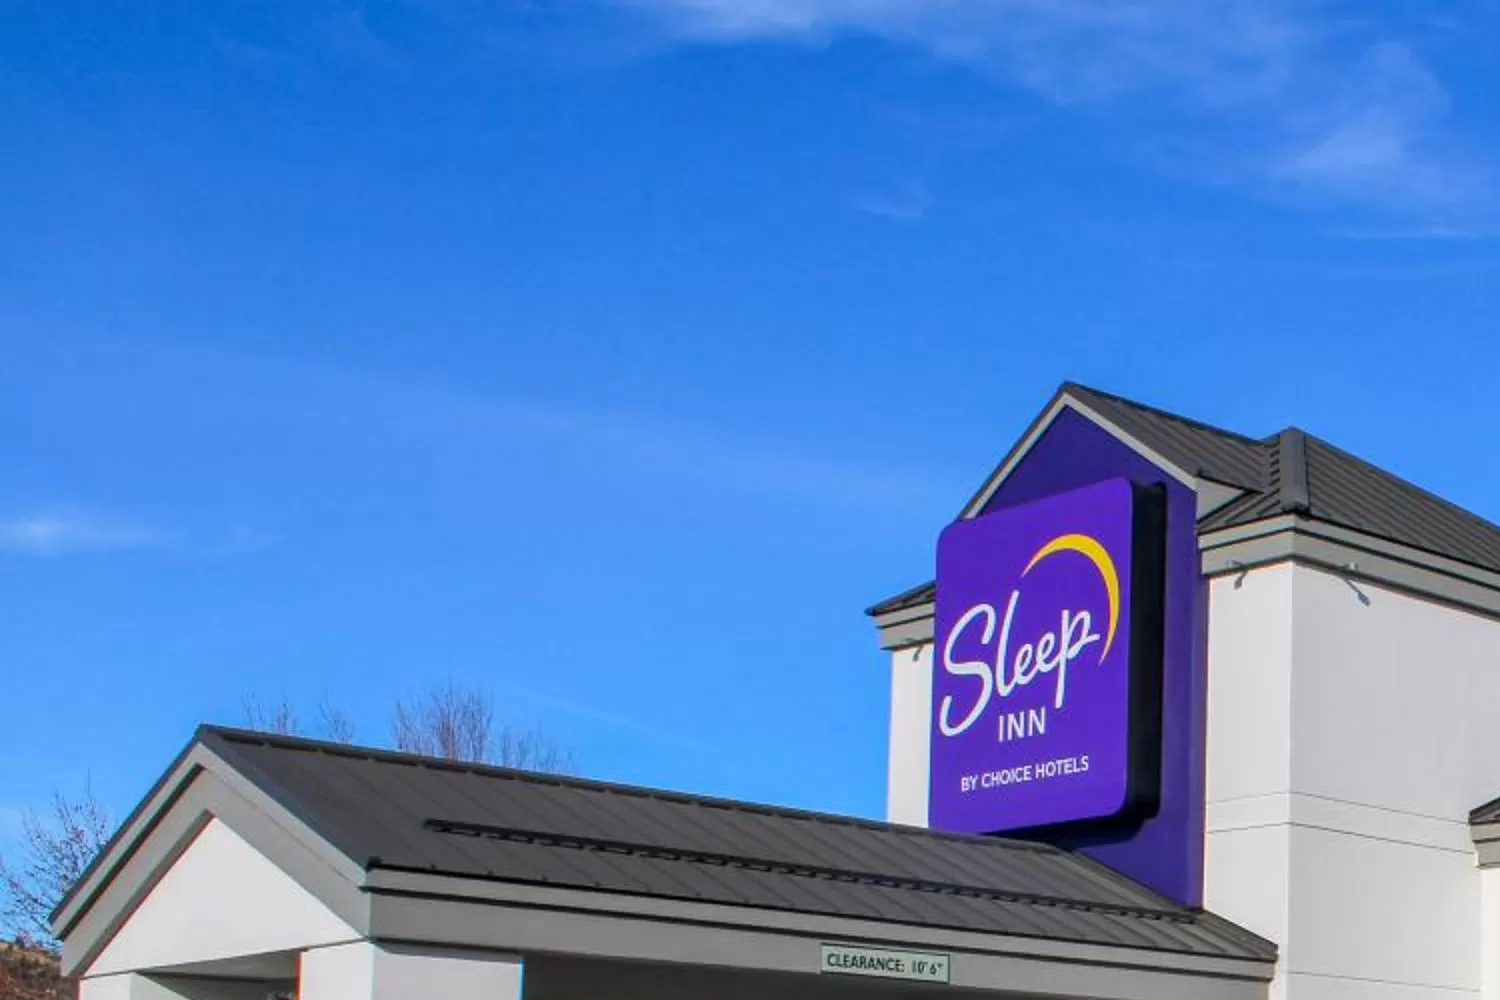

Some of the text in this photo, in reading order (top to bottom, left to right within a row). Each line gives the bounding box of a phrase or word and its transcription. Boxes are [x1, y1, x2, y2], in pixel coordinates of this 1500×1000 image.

[939, 590, 1100, 736] Sleep
[998, 707, 1046, 742] INN
[961, 755, 1089, 792] BY CHOICE HOTELS
[827, 953, 904, 973] CLEARANCE:
